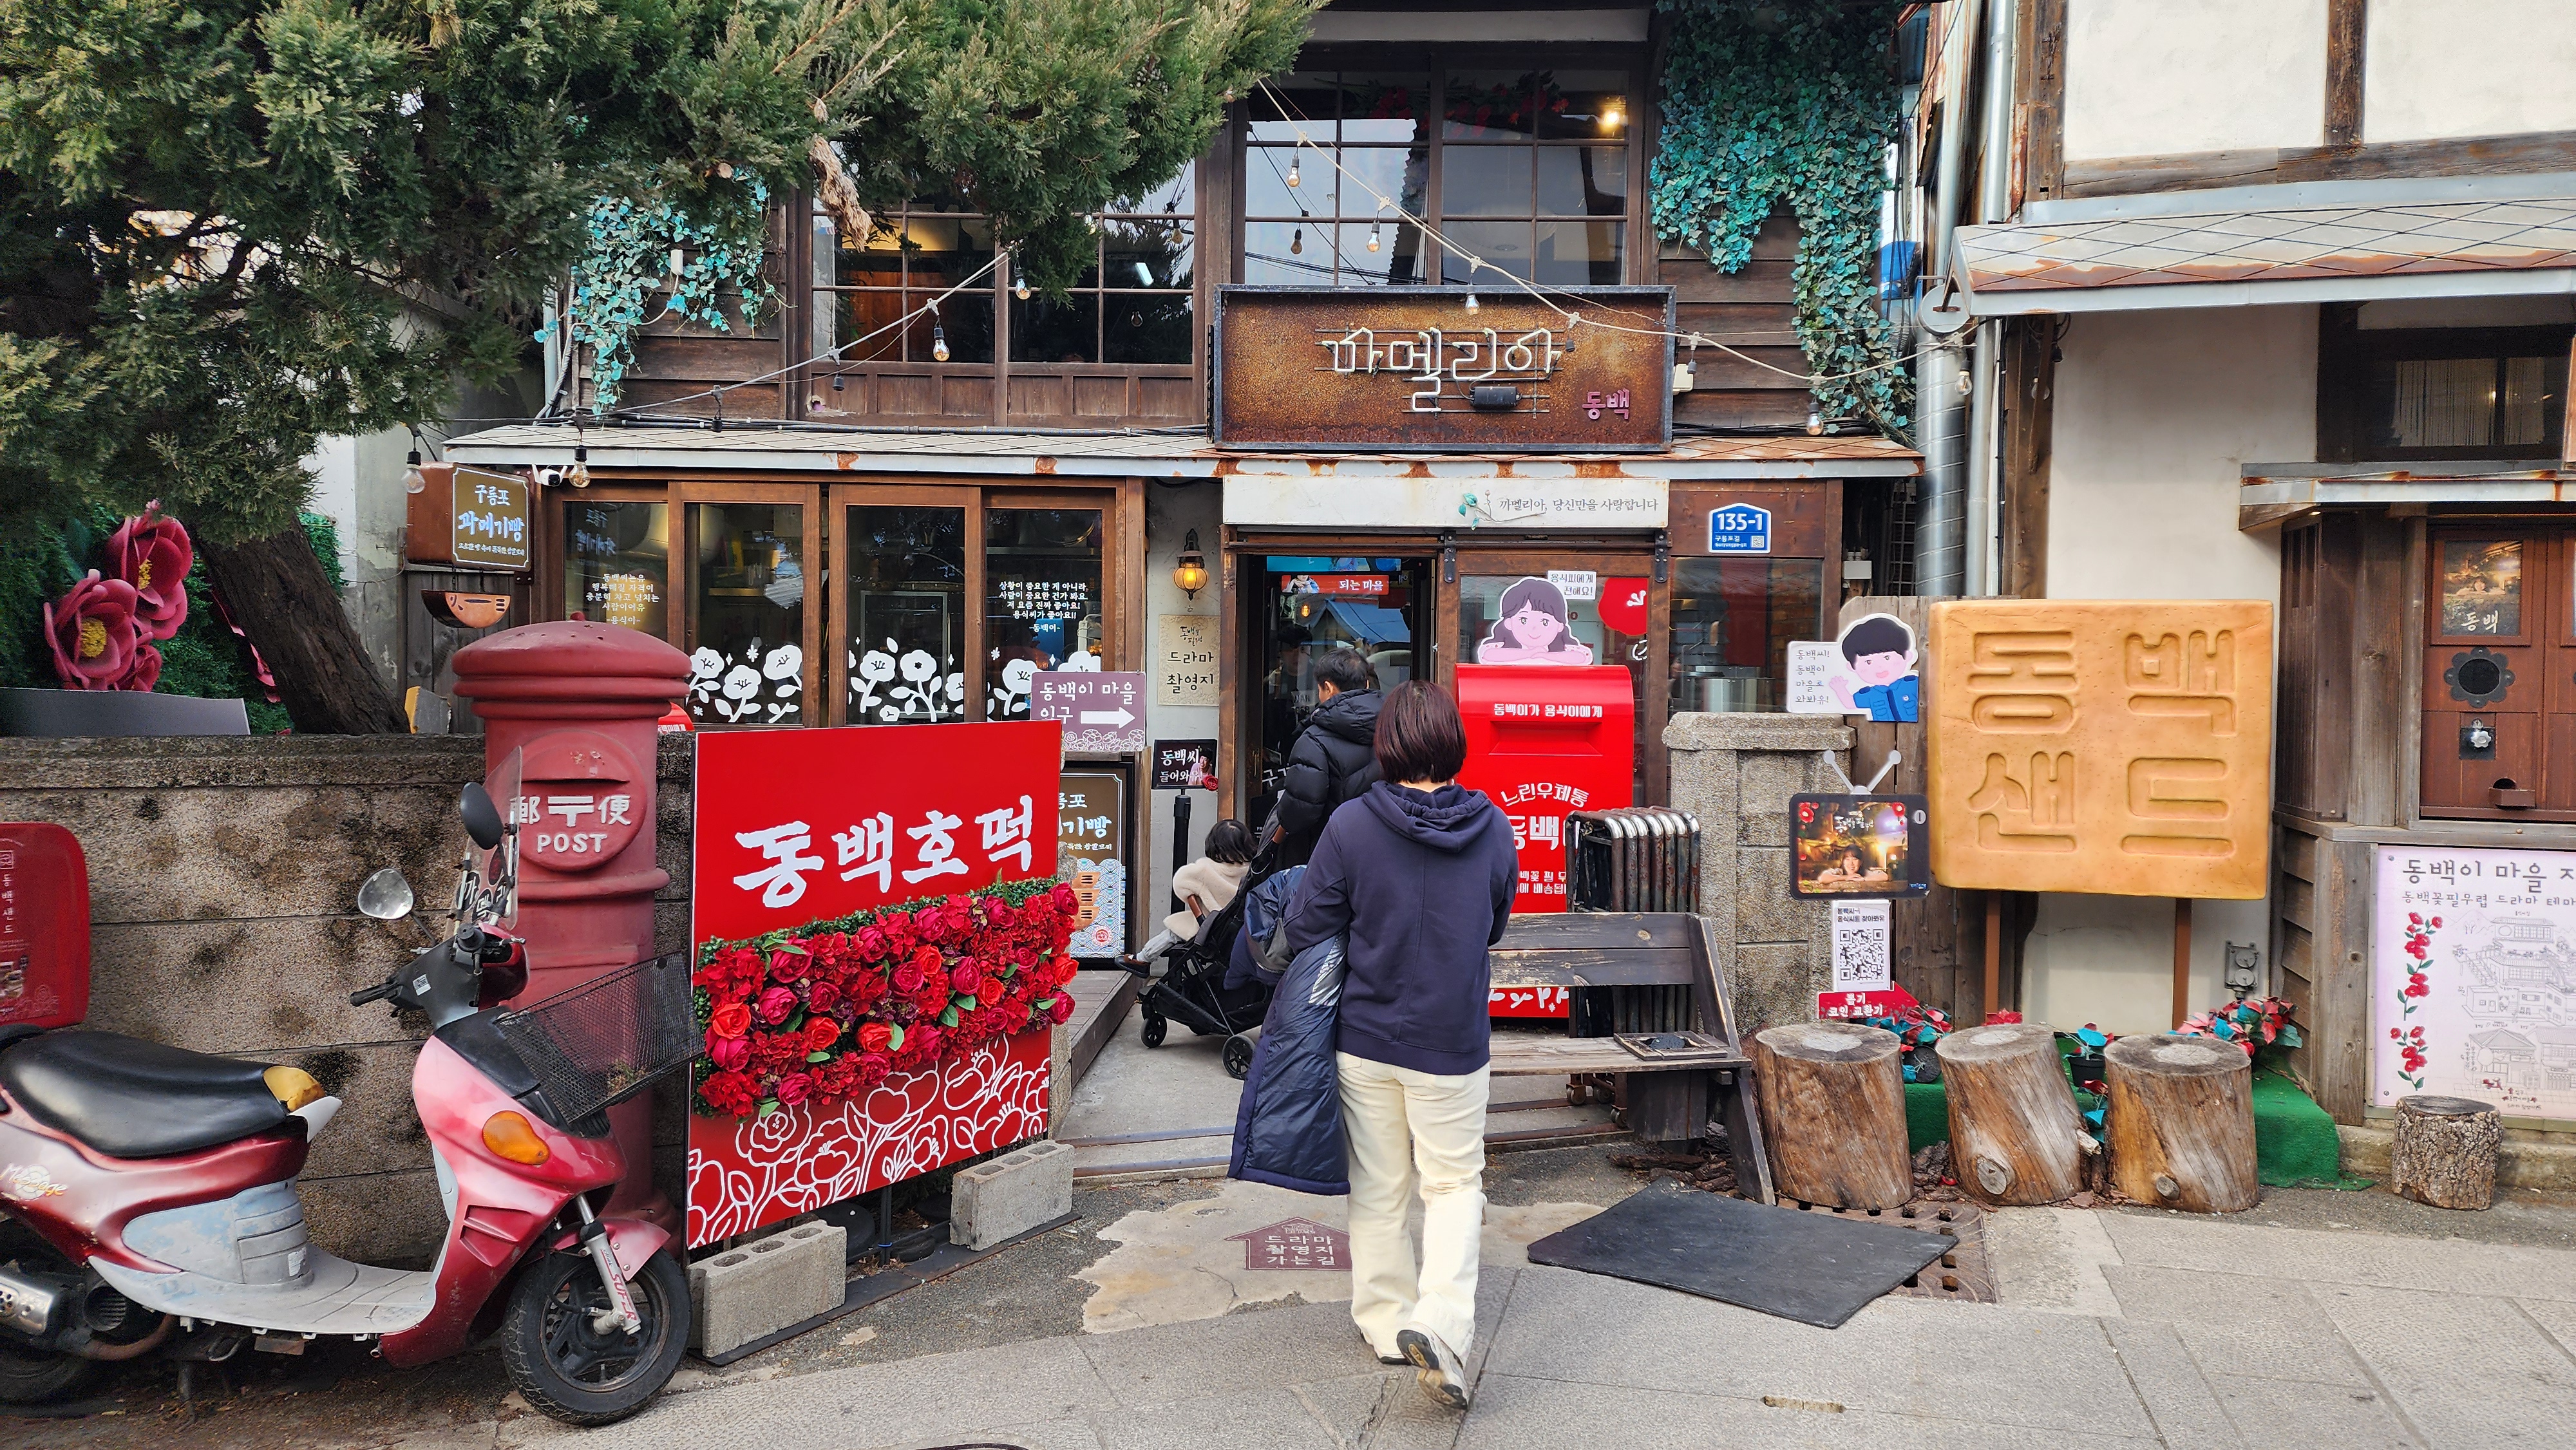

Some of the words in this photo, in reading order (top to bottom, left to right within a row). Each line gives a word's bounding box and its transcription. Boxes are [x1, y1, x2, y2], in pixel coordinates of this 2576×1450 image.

[1582, 388, 1631, 420] 동백
[474, 484, 511, 506] 구룡포
[1499, 498, 1548, 512] 까멜리아,
[1553, 498, 1598, 512] 당신만을
[1600, 498, 1659, 512] 사랑합니다
[458, 510, 525, 542] 과메기빵
[1717, 513, 1763, 531] 135-1
[1339, 578, 1361, 591] 되는
[1362, 579, 1384, 591] 마을
[1551, 573, 1594, 583] 용식씨에게
[999, 581, 1023, 590] 상황이
[1025, 581, 1050, 590] 중요한
[1052, 582, 1060, 590] 게
[1564, 586, 1593, 596] 전해요!
[585, 592, 611, 601] 충분히
[634, 593, 660, 603] 넘치는
[998, 591, 1023, 600] 사람이
[1025, 591, 1050, 600] 중요한
[1007, 601, 1015, 610] 저
[1035, 601, 1052, 610] 진짜
[1012, 610, 1045, 619] 용식씨가
[2461, 610, 2499, 634] 동백
[1167, 650, 1215, 664] 드라마
[1795, 650, 1830, 661] 동백씨!
[1795, 665, 1825, 675] 동백이
[1166, 672, 1214, 694] 촬영지
[1796, 679, 1824, 692] 마을로
[1967, 630, 2238, 737] 동백
[1039, 681, 1094, 702] 동백이
[1101, 681, 1137, 705] 마을
[1795, 694, 1830, 705] 와봐유!
[1039, 705, 1074, 724] 입구
[1493, 703, 1540, 717] 동백이가
[1544, 704, 1603, 718] 용식이에게
[1160, 748, 1200, 766] 동백씨
[1159, 769, 1203, 784] 들어와유!
[1501, 782, 1589, 808] 느린우체통
[1967, 750, 2237, 856] 샌드
[1058, 813, 1113, 838] 기빵
[536, 833, 608, 853] POST
[733, 794, 1033, 909] 동백호떡
[1544, 871, 1554, 883] 필
[2402, 859, 2481, 885] 동백이
[2496, 861, 2548, 894] 마을
[1533, 883, 1567, 894] 배송됩
[2496, 895, 2538, 905] 드라마
[2546, 896, 2576, 907] 테마
[1845, 992, 1866, 1006] 뽑기
[1827, 1004, 1849, 1017] 코인
[1852, 1003, 1883, 1017] 교환기
[1264, 1235, 1334, 1245] 드라마
[1264, 1245, 1334, 1256] 촬영지
[1266, 1256, 1336, 1266] 가는길
